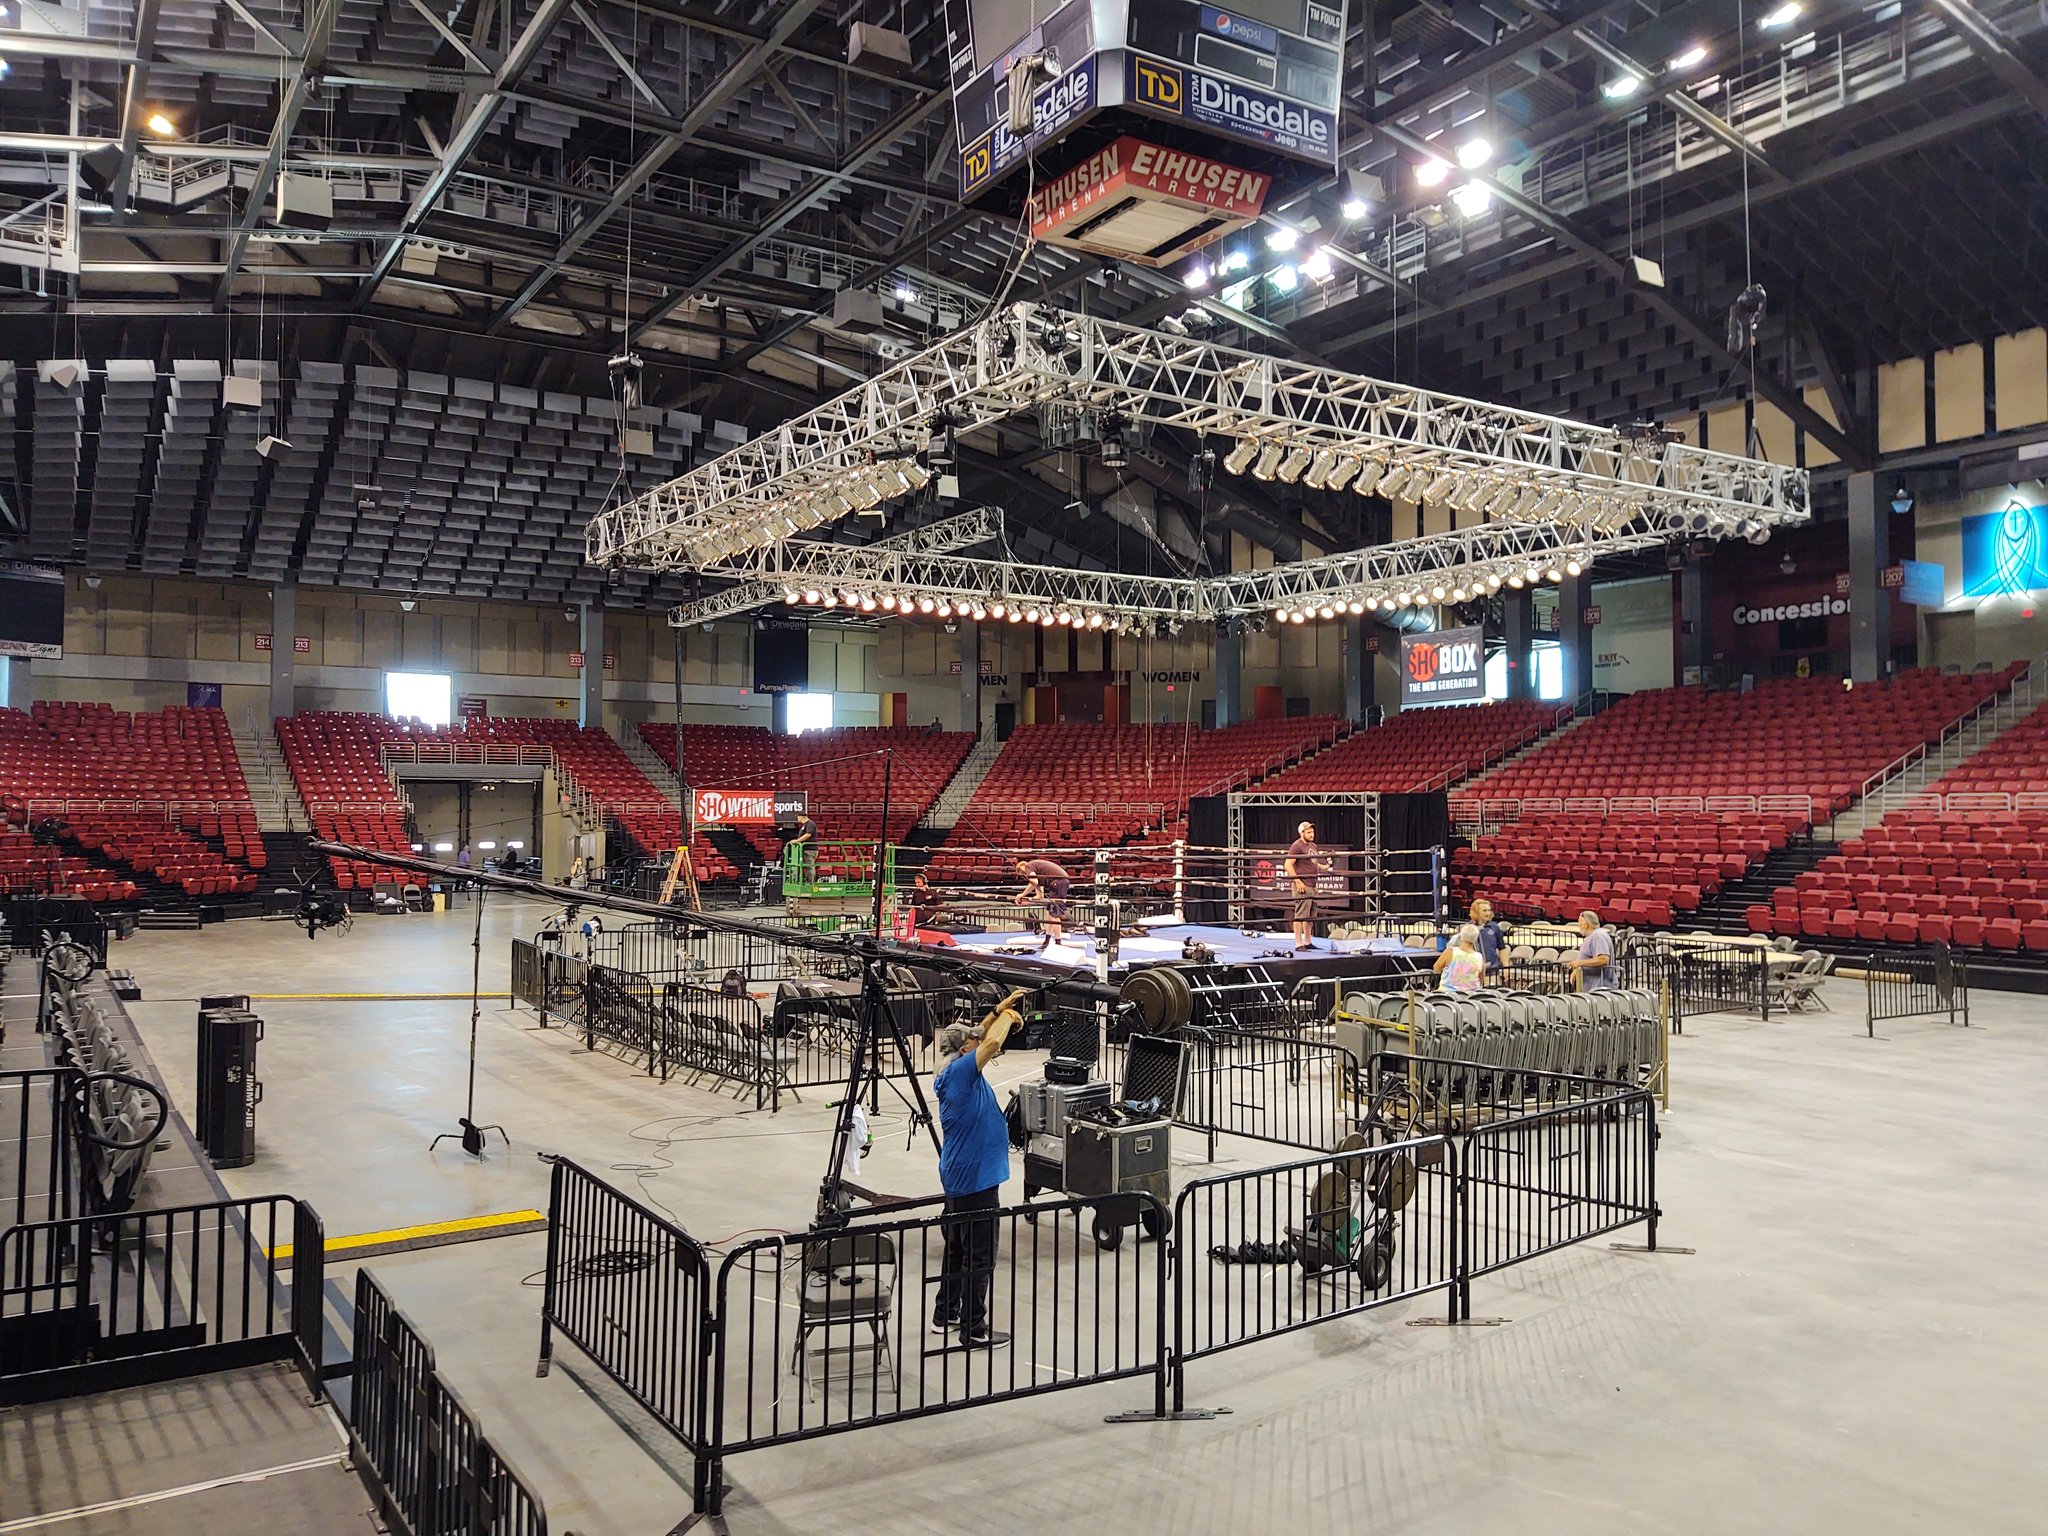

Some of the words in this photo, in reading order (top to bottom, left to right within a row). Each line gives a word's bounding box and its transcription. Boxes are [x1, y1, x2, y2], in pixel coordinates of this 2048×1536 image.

[1321, 11, 1340, 29] FOULS
[1232, 23, 1262, 40] pepsi
[1140, 68, 1179, 103] TD
[1000, 72, 1089, 152] Dsdale
[1191, 74, 1200, 103] TOM
[1201, 76, 1328, 142] Dinsdale
[1275, 133, 1297, 149] Jeep
[966, 148, 988, 181] TD
[1131, 144, 1263, 204] EIHUSEN
[1033, 144, 1119, 225] EIHUSEN
[1148, 175, 1234, 209] ARENA
[1047, 183, 1106, 228] ARENA
[1837, 579, 1849, 590] 20
[1885, 571, 1903, 582] 207
[256, 638, 270, 646] 214
[1598, 653, 1618, 662] EXIT
[1142, 671, 1200, 683] WOMEN
[1408, 682, 1422, 693] THE
[1422, 680, 1437, 692] NEW
[1438, 677, 1478, 691] GENERATION
[697, 793, 773, 820] SHOWTIME
[774, 801, 804, 814] sports
